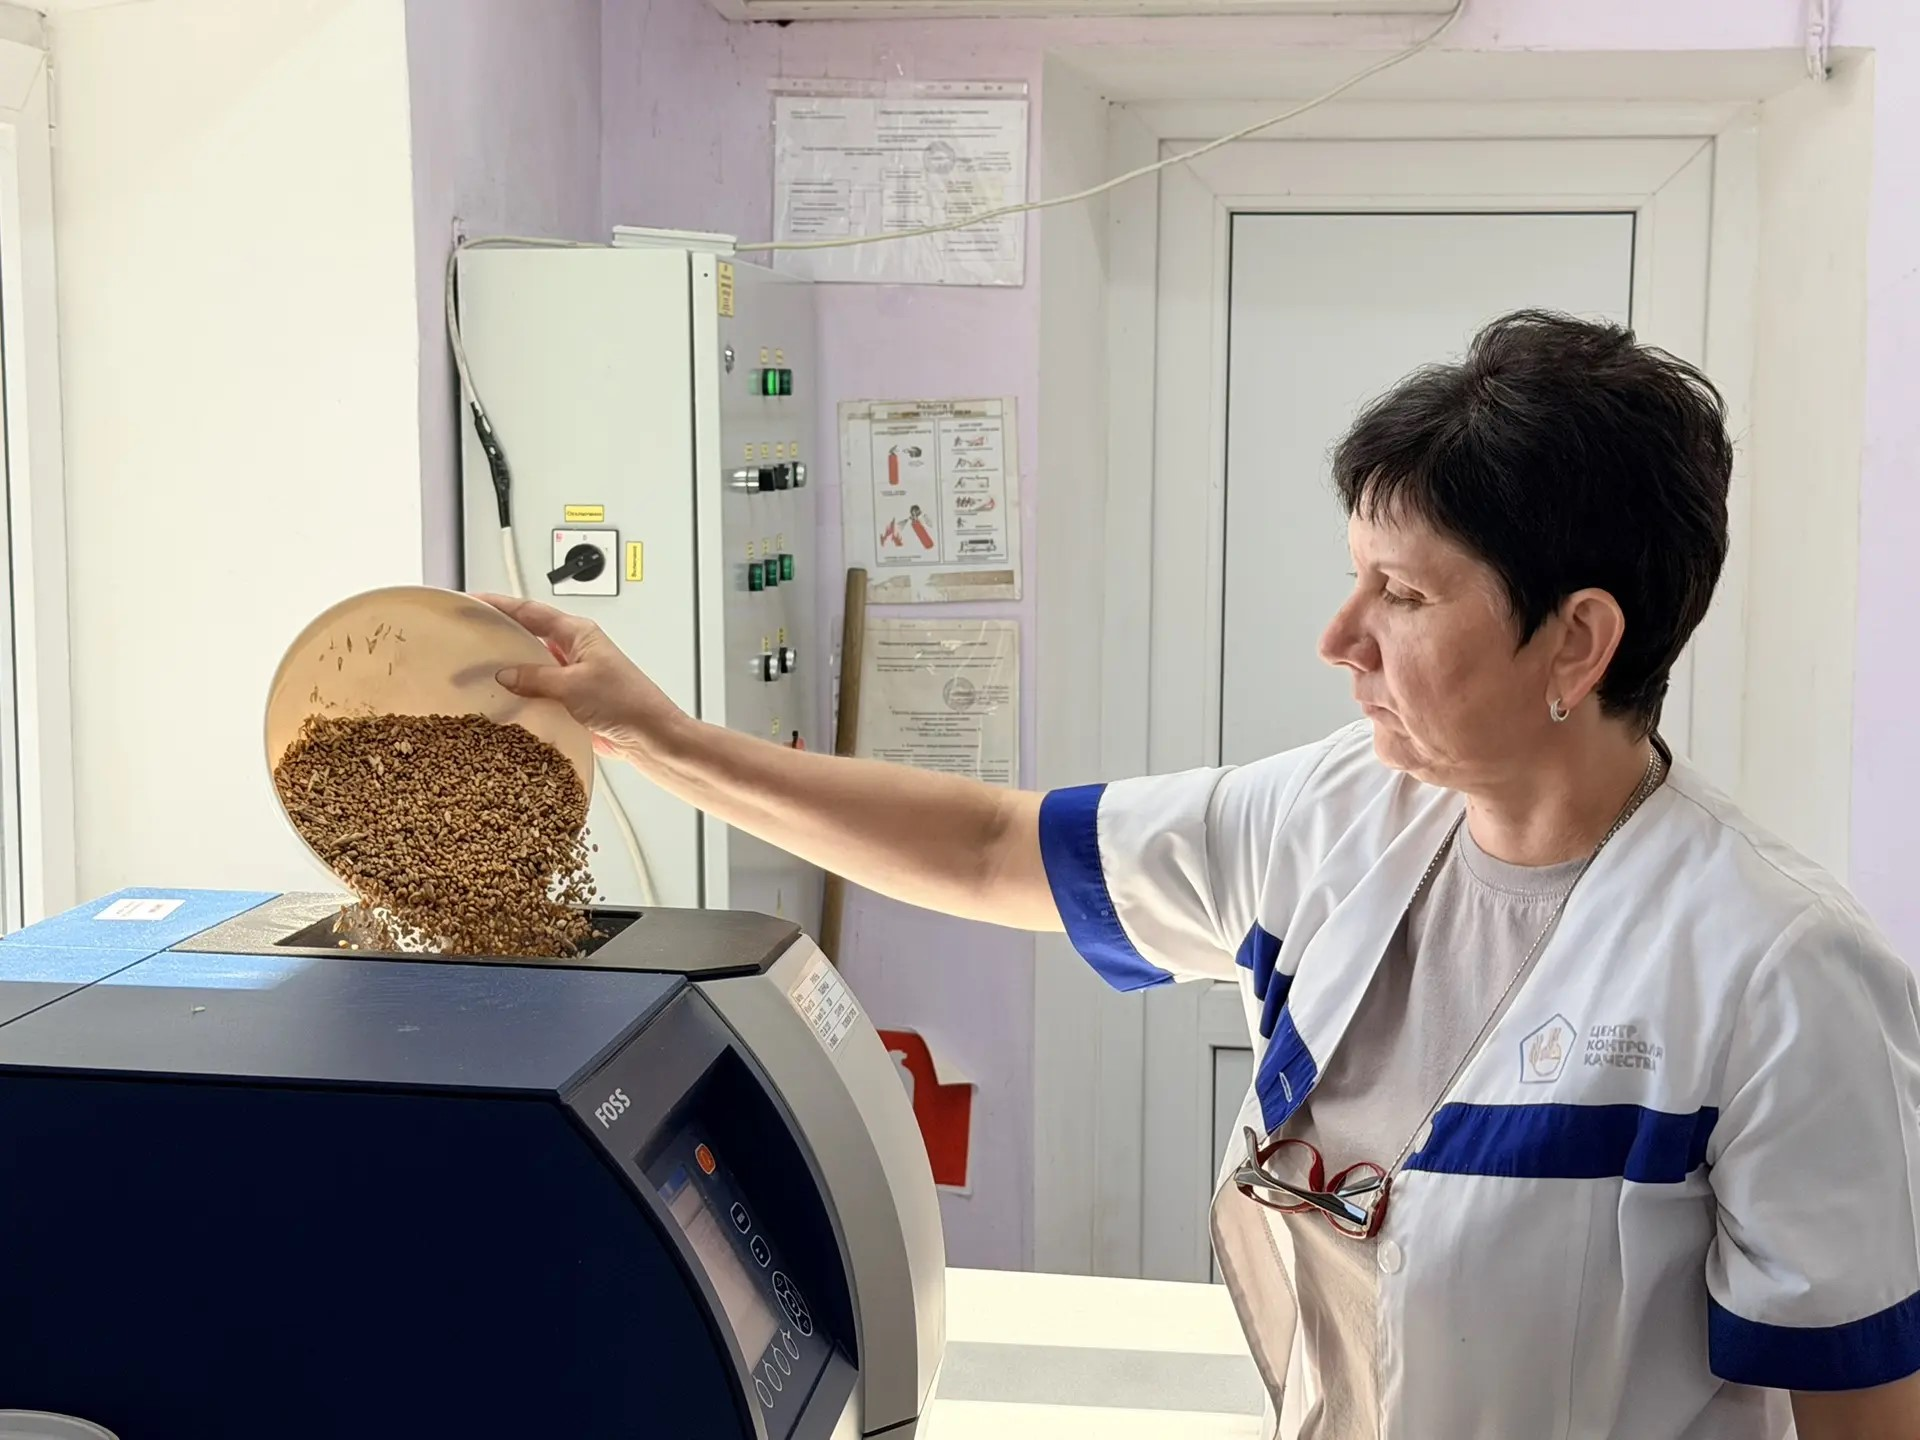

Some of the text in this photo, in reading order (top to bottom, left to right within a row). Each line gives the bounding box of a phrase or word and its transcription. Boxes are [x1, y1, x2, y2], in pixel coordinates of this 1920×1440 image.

[1590, 1024, 1638, 1039] ЦЕНТР
[1586, 1039, 1664, 1058] КОНТРОЛЯ
[594, 1087, 631, 1129] FOSS
